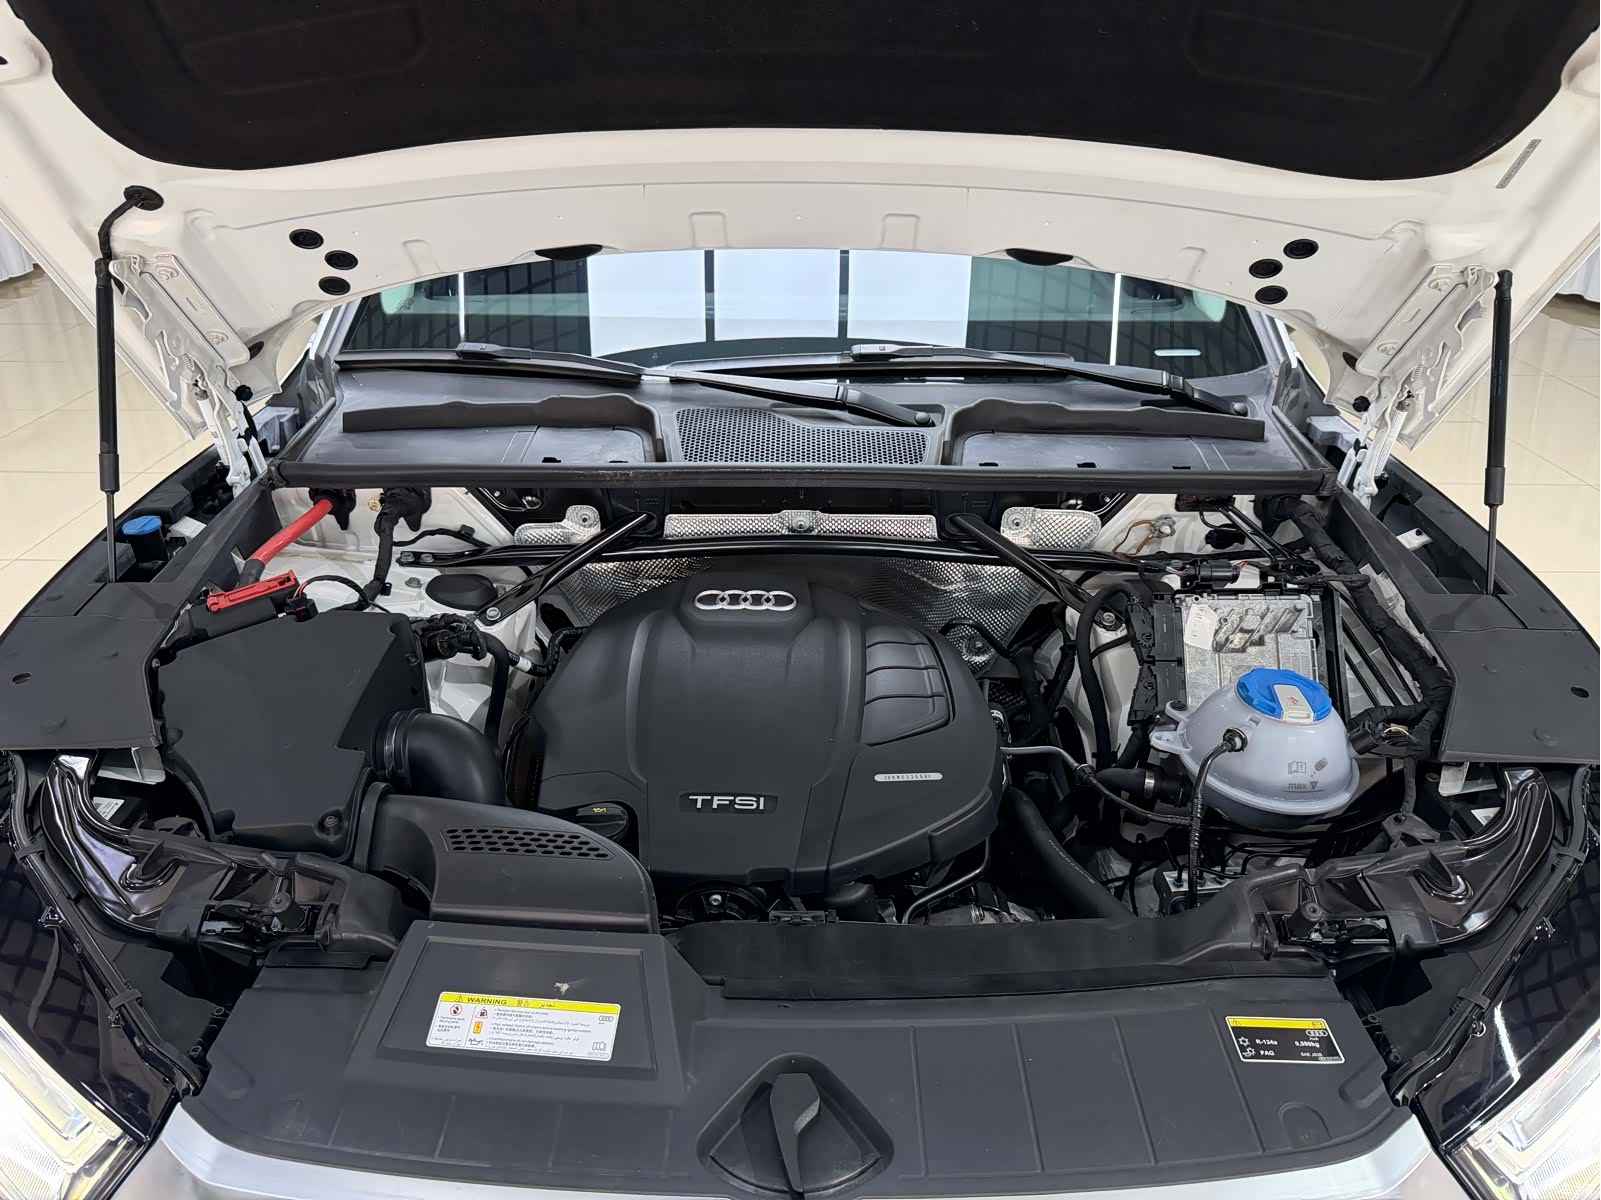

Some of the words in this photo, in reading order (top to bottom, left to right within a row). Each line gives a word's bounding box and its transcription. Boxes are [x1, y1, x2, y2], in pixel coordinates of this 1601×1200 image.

[1288, 782, 1307, 790] max
[688, 795, 765, 810] TFSI
[467, 996, 507, 1005] WARNING
